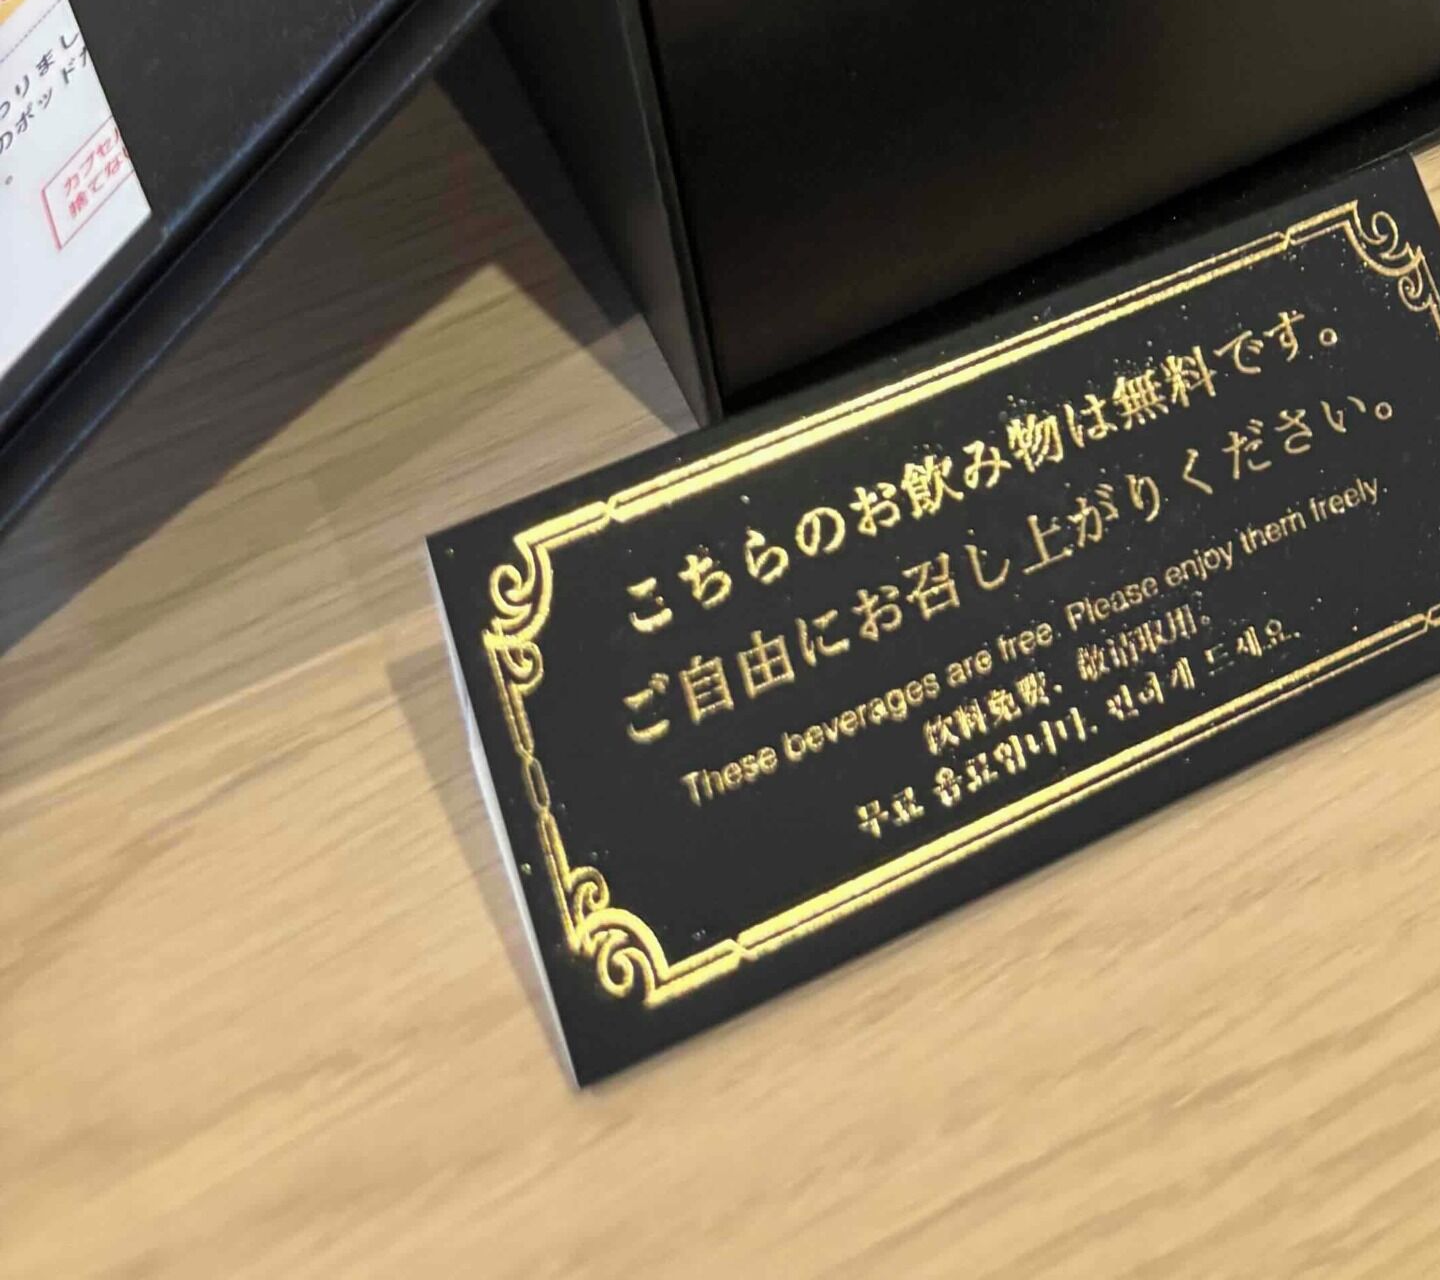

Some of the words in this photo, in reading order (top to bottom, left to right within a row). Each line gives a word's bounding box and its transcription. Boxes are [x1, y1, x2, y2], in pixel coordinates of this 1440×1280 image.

[623, 395, 1393, 744] ご自由にお召し上がりください。
[627, 310, 1338, 634] こちらのお飲み物は無料です。
[679, 747, 780, 808] These
[783, 671, 941, 765] beverages
[946, 648, 993, 687] are
[998, 622, 1061, 664] free.
[1066, 574, 1160, 632] Please
[1165, 540, 1235, 589] enjoy
[1240, 509, 1307, 555] them
[856, 784, 926, 839] 무료
[934, 706, 1099, 808] 음료입니다.
